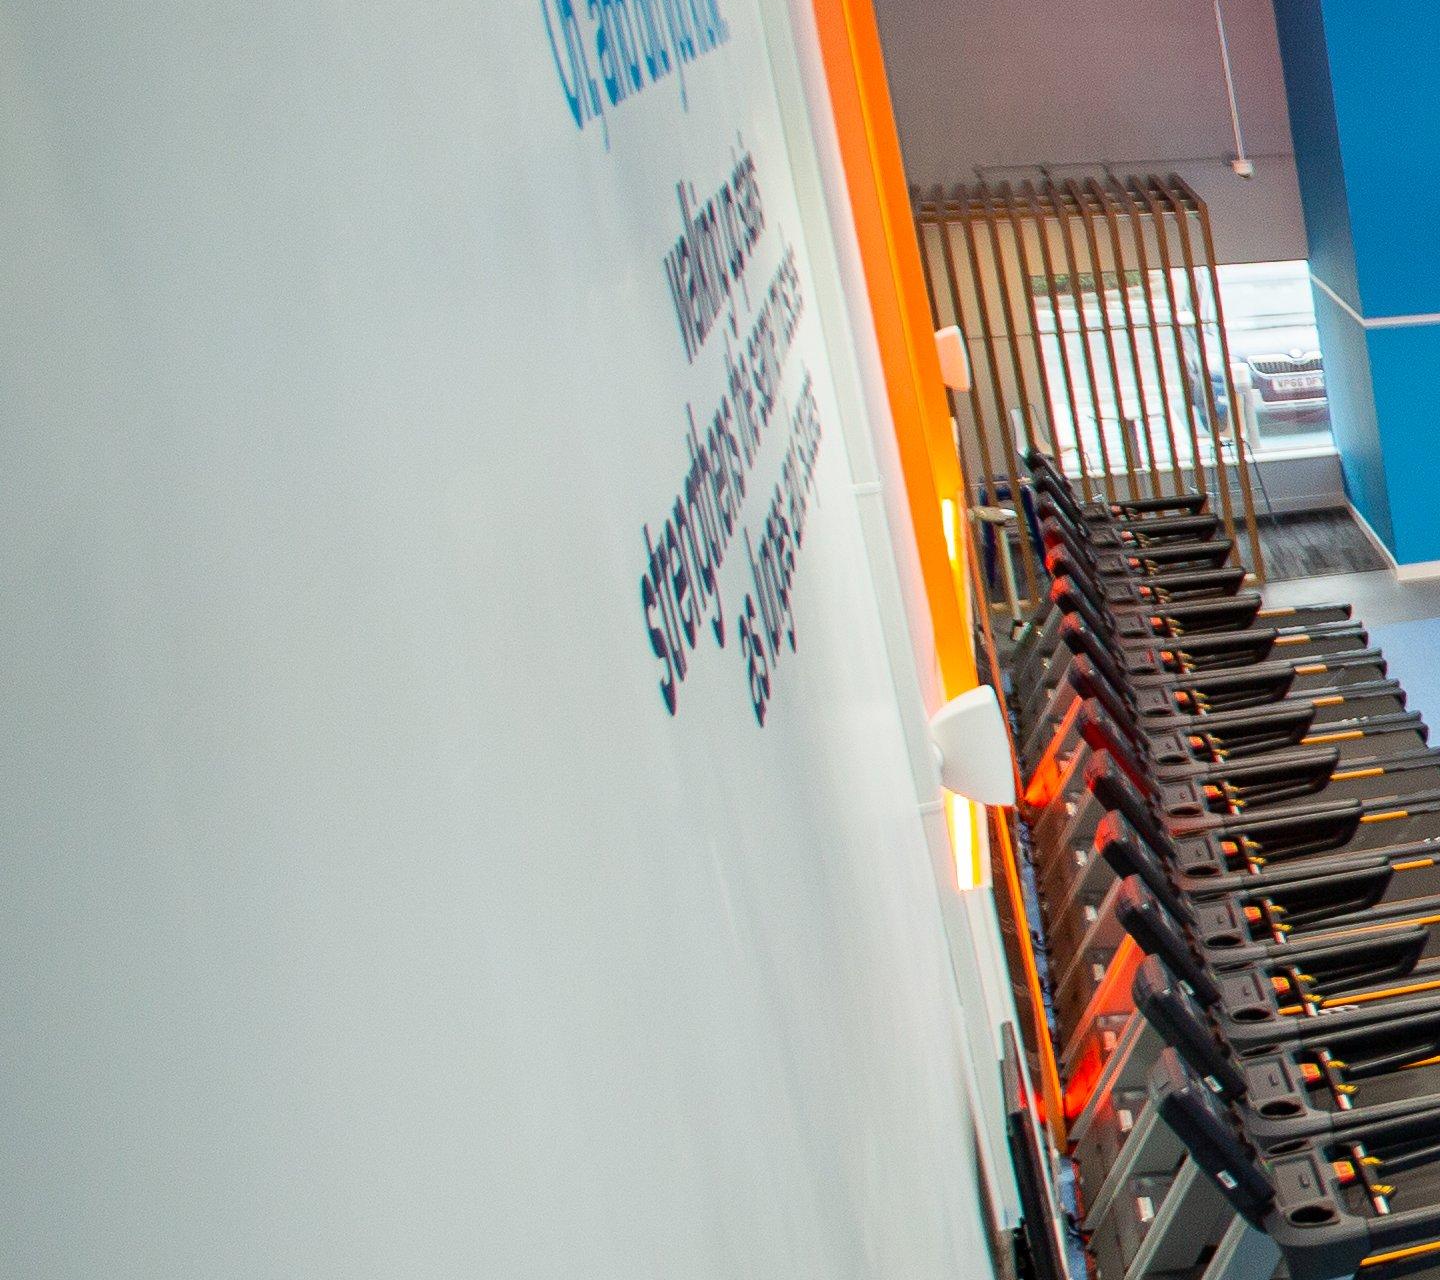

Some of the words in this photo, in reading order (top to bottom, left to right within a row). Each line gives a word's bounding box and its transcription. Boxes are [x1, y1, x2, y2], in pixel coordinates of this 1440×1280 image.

[641, 402, 746, 716] strengthens
[744, 483, 797, 666] lunges
[738, 594, 771, 726] as
